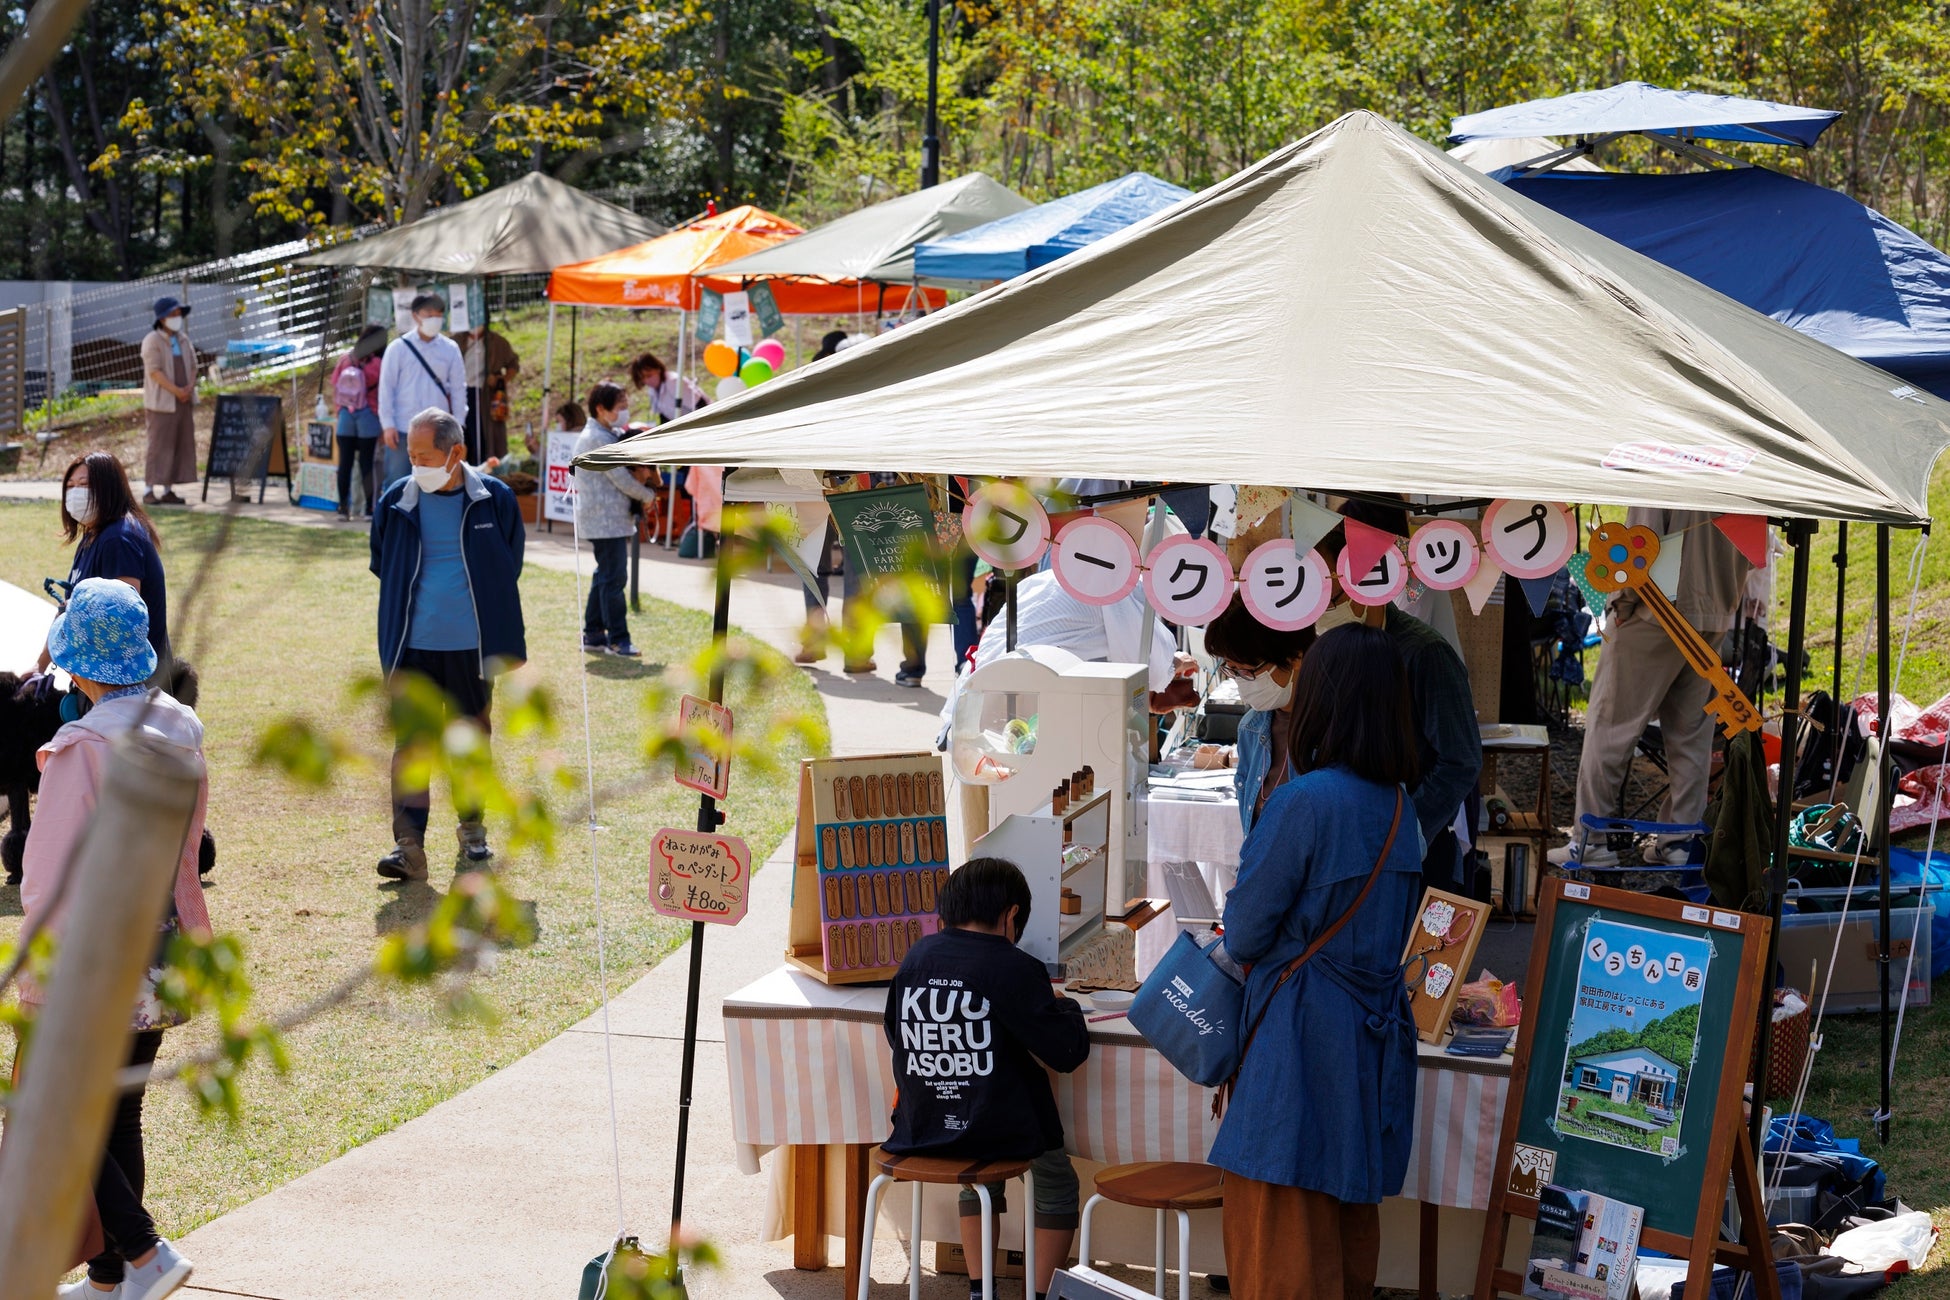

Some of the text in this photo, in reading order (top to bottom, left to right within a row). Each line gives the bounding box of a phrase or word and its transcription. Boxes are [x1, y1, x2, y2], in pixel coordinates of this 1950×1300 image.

[868, 533, 919, 546] YAKUSHI
[878, 546, 914, 555] LOCA
[878, 564, 925, 574] MARET
[987, 503, 1549, 609] ワークショップ
[1723, 689, 1752, 724] 203
[665, 838, 720, 859] ねこかがみ
[687, 884, 726, 911] ¥800
[1591, 942, 1701, 989] くうちん工房
[928, 978, 963, 987] CHILD JOB
[901, 986, 991, 1023] KUU
[1579, 997, 1625, 1014] 家具工房です
[1580, 984, 1666, 1010] 町田市のはじっこにある
[1161, 987, 1214, 1036] nice day
[900, 1020, 992, 1051] NERU
[906, 1051, 994, 1077] ASOBU
